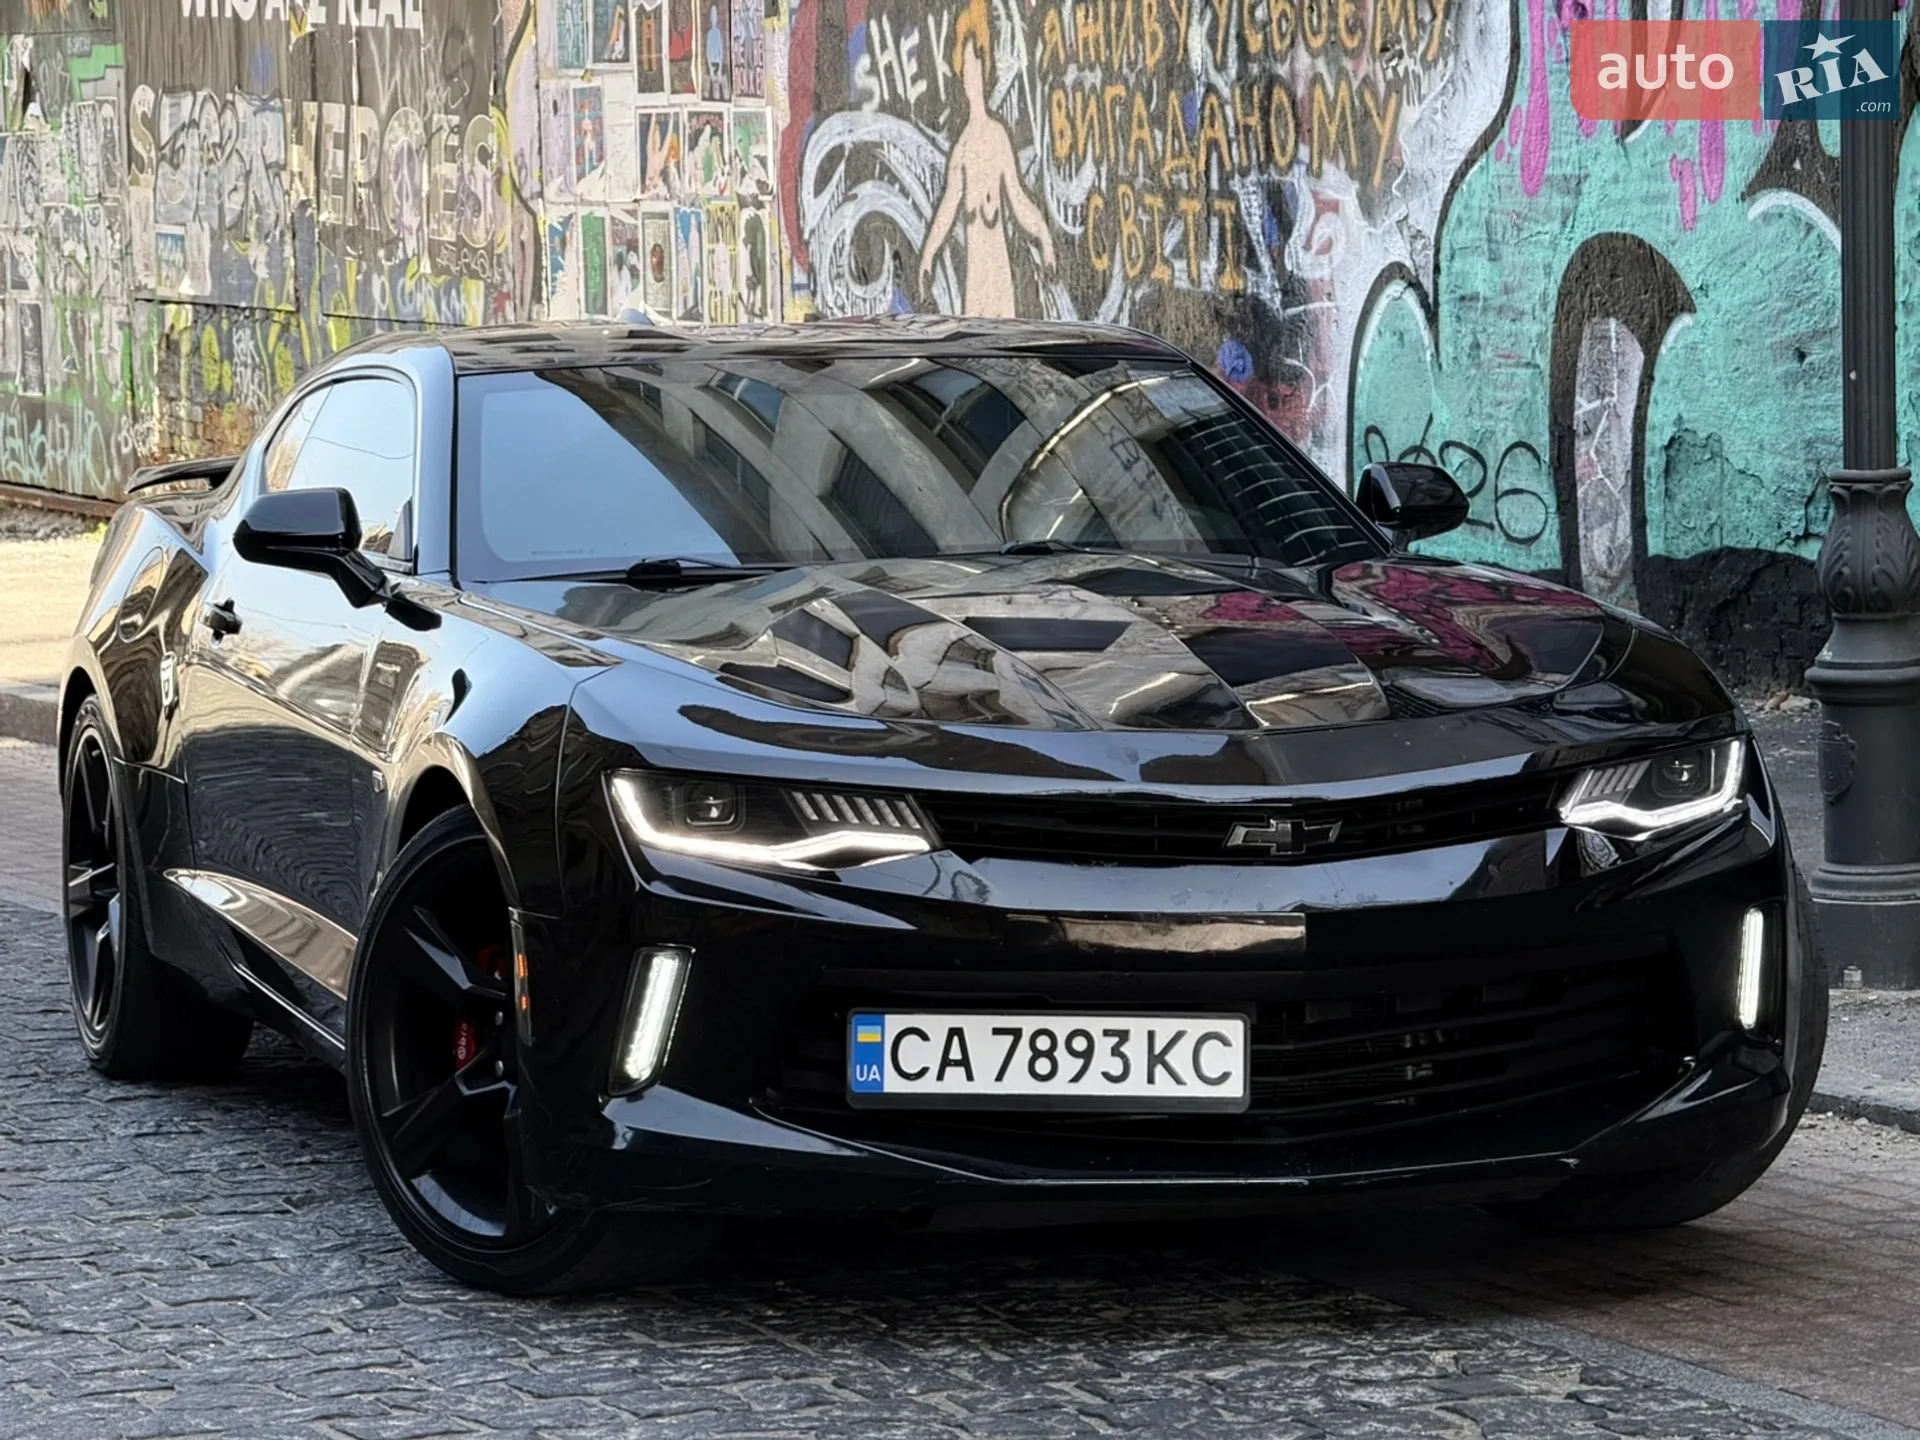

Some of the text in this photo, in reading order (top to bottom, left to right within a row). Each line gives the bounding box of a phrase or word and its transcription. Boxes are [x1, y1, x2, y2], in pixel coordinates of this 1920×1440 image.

[855, 13, 928, 116] SHE
[1042, 7, 1066, 71] Я
[1050, 79, 1398, 189] ВИГАДАНОМУ
[1087, 184, 1247, 291] СВІТІ
[856, 1064, 881, 1083] UA
[890, 1026, 1233, 1087] CA 7893 KC
